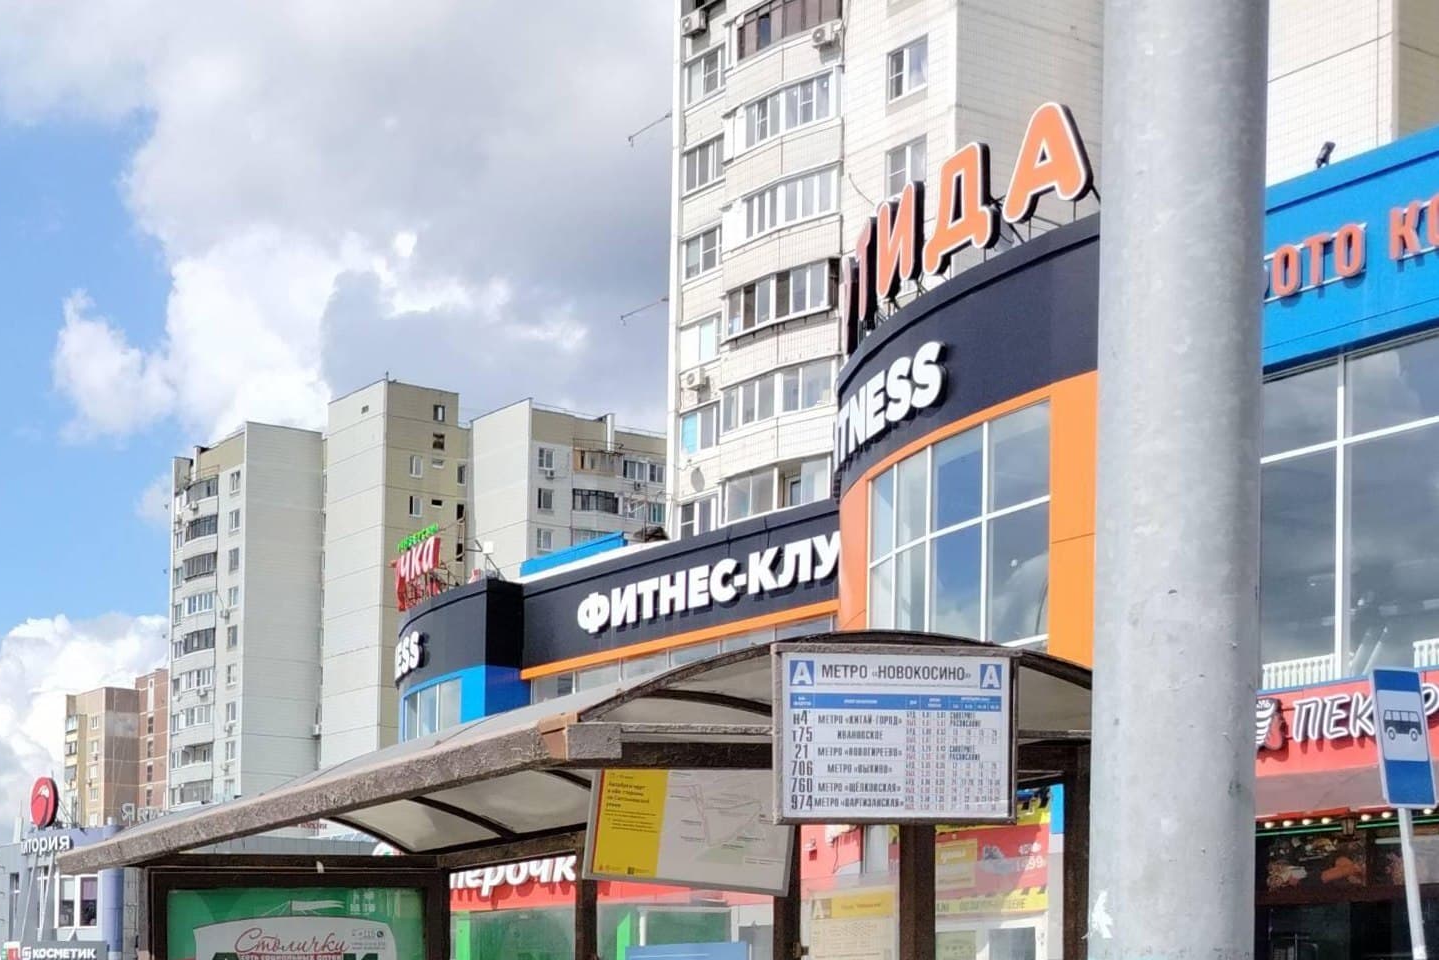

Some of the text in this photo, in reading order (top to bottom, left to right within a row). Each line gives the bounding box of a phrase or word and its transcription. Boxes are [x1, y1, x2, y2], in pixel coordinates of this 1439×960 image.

[1264, 223, 1366, 301] ОТО
[577, 531, 840, 634] ФИТНЕС-КЛУ
[821, 664, 868, 679] МЕТРО
[872, 665, 971, 681] «НОВОКОСИНО»
[817, 714, 843, 724] МЕТРО
[795, 743, 808, 759] 21
[817, 747, 843, 756] МЕТРО
[791, 760, 813, 776] 706
[827, 764, 852, 773] МЕТРО
[791, 777, 813, 793] 760
[817, 783, 843, 792] МЕТРО
[791, 794, 813, 810] 974
[814, 798, 840, 807] МЕТРО
[235, 927, 348, 953] Столички
[33, 947, 97, 959] КОСМЕТИК
